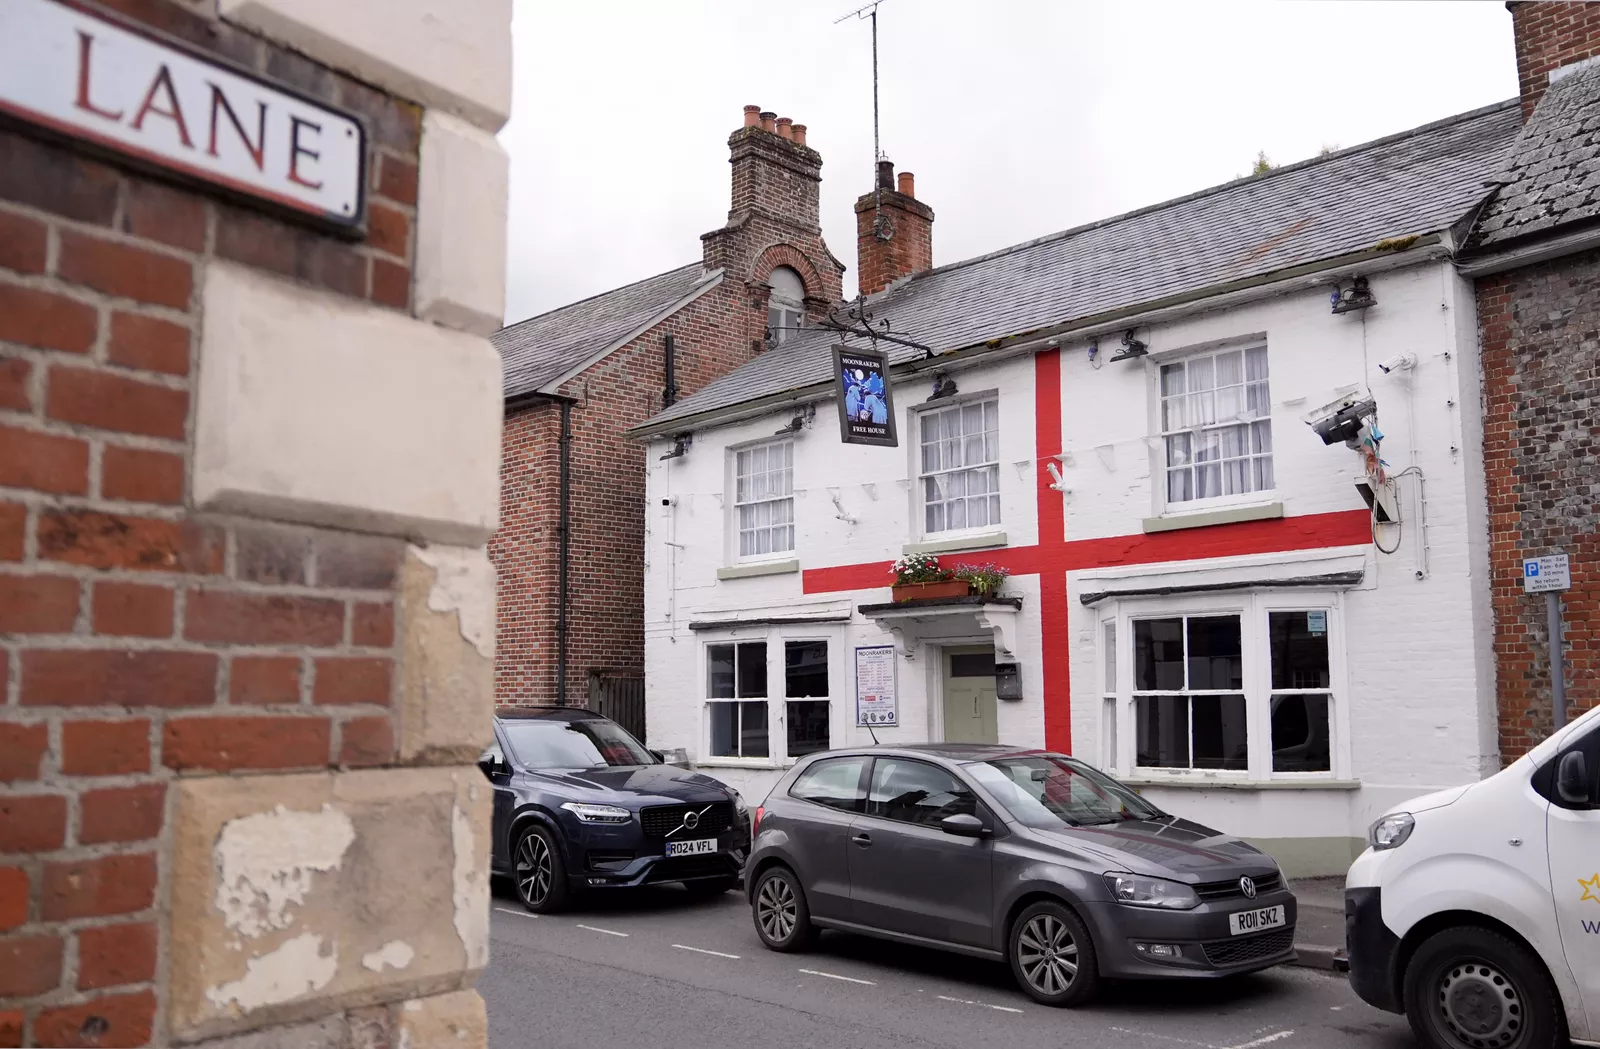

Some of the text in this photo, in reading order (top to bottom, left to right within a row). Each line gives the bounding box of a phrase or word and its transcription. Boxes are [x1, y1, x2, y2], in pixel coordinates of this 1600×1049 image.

[74, 27, 323, 190] LANE
[842, 357, 880, 369] MOONRAKERS
[852, 425, 886, 435] FREE HOUSE
[858, 649, 892, 657] MOONRAKERS
[670, 841, 713, 855] RO24 VFL
[1238, 908, 1278, 931] RO11 SKZ
